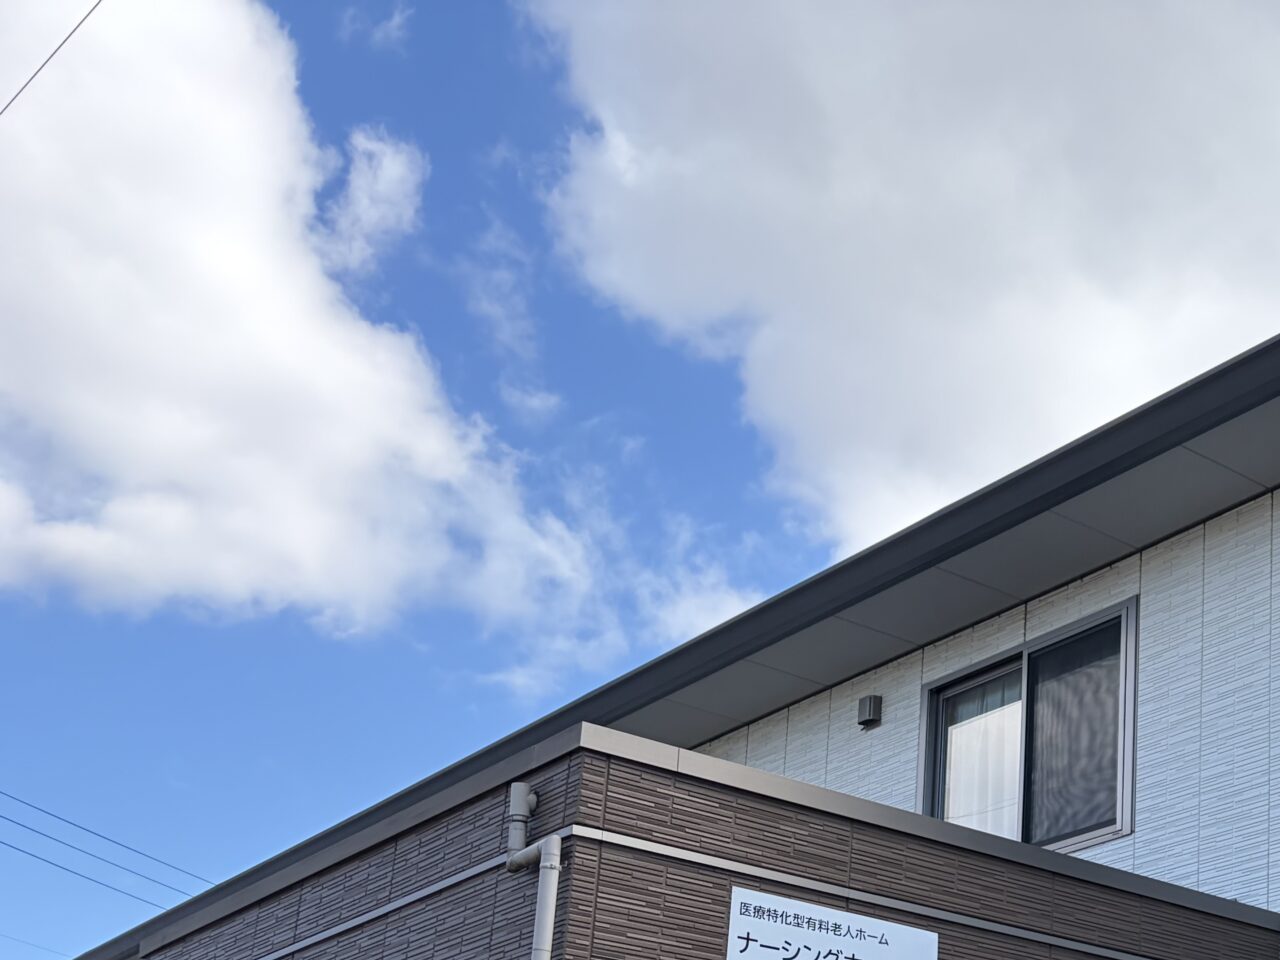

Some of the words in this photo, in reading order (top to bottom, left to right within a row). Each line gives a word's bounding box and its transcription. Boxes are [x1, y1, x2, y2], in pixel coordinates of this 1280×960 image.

[739, 901, 889, 946] 医療特化型有料老人ホーム
